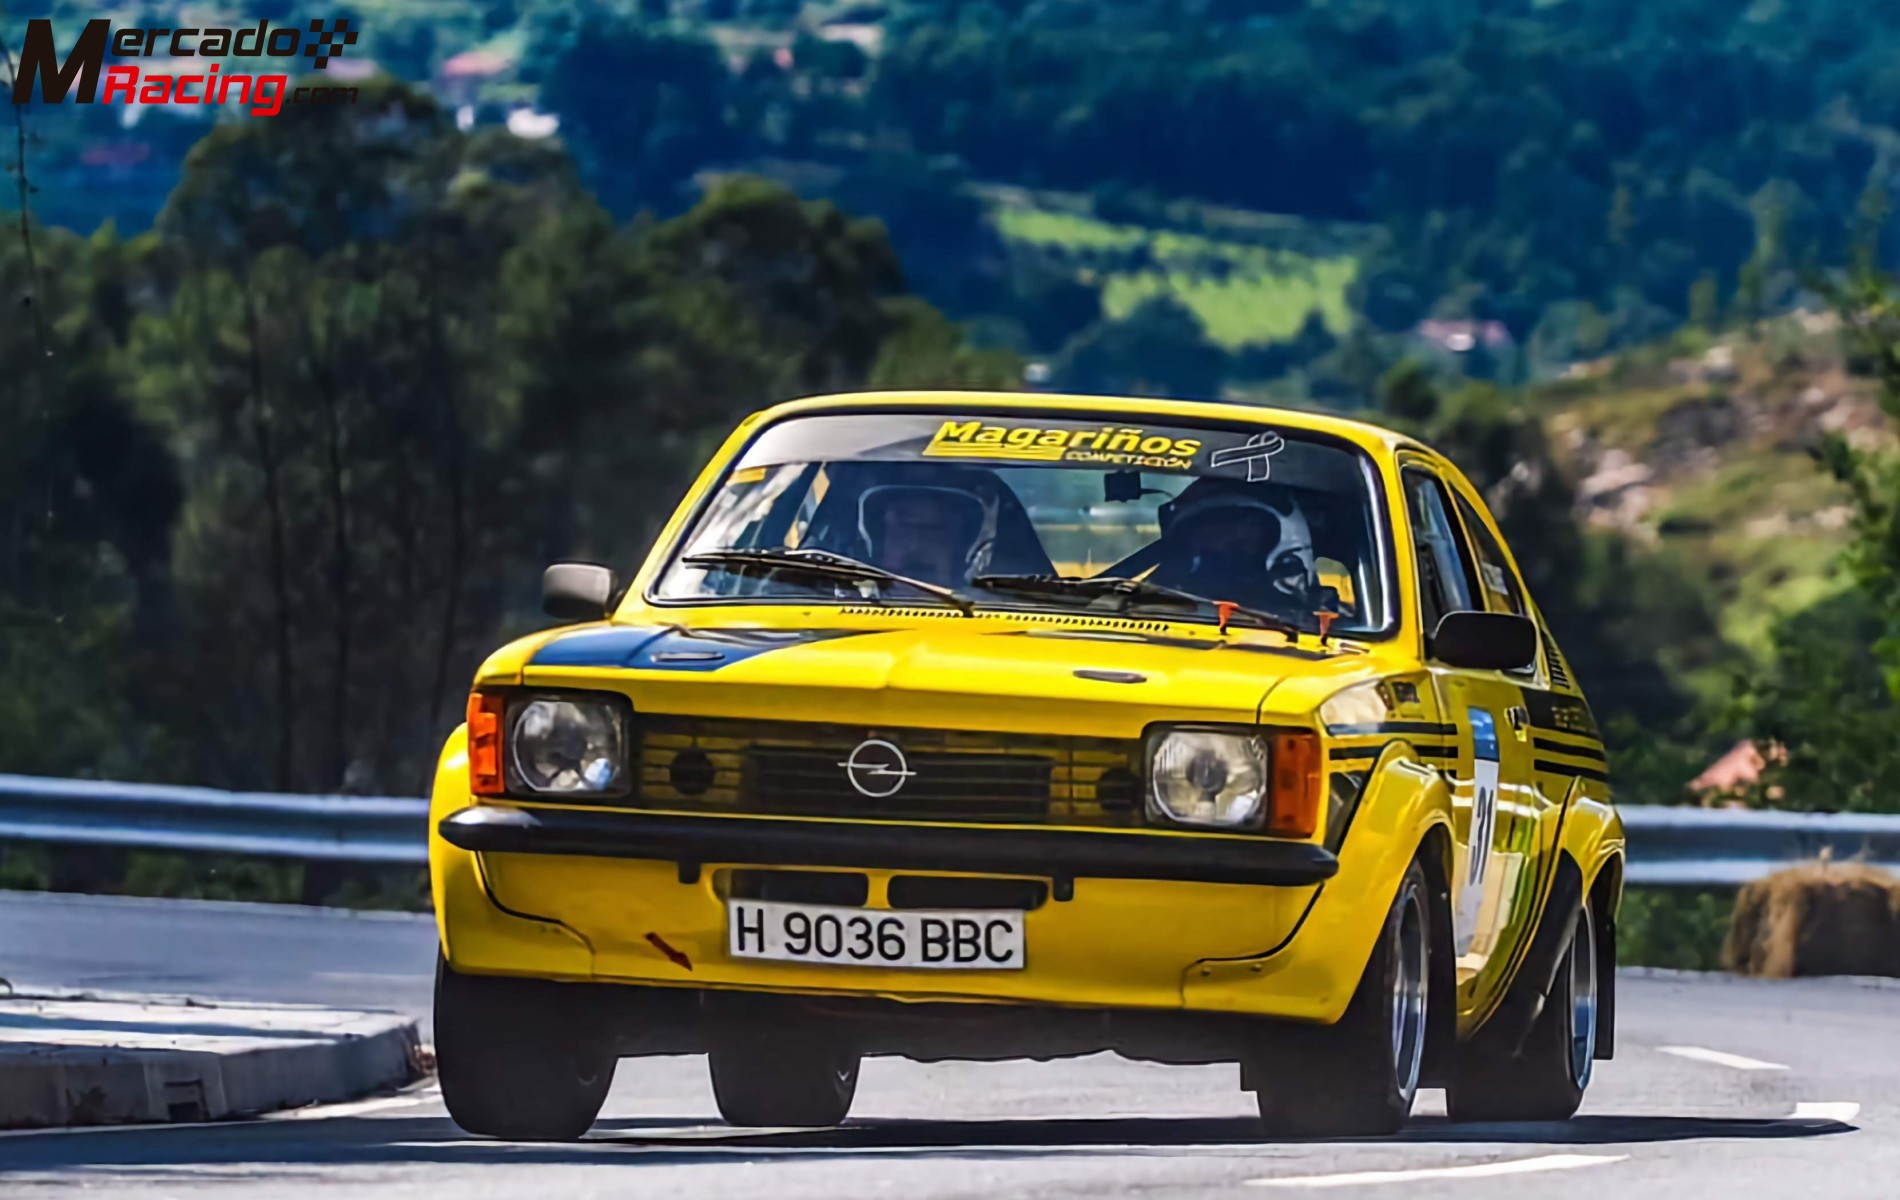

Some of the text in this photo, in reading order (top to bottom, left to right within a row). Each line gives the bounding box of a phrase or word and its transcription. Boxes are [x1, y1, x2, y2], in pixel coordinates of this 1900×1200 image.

[928, 421, 1201, 458] Magariños
[737, 906, 1013, 963] H 9036 BBC
